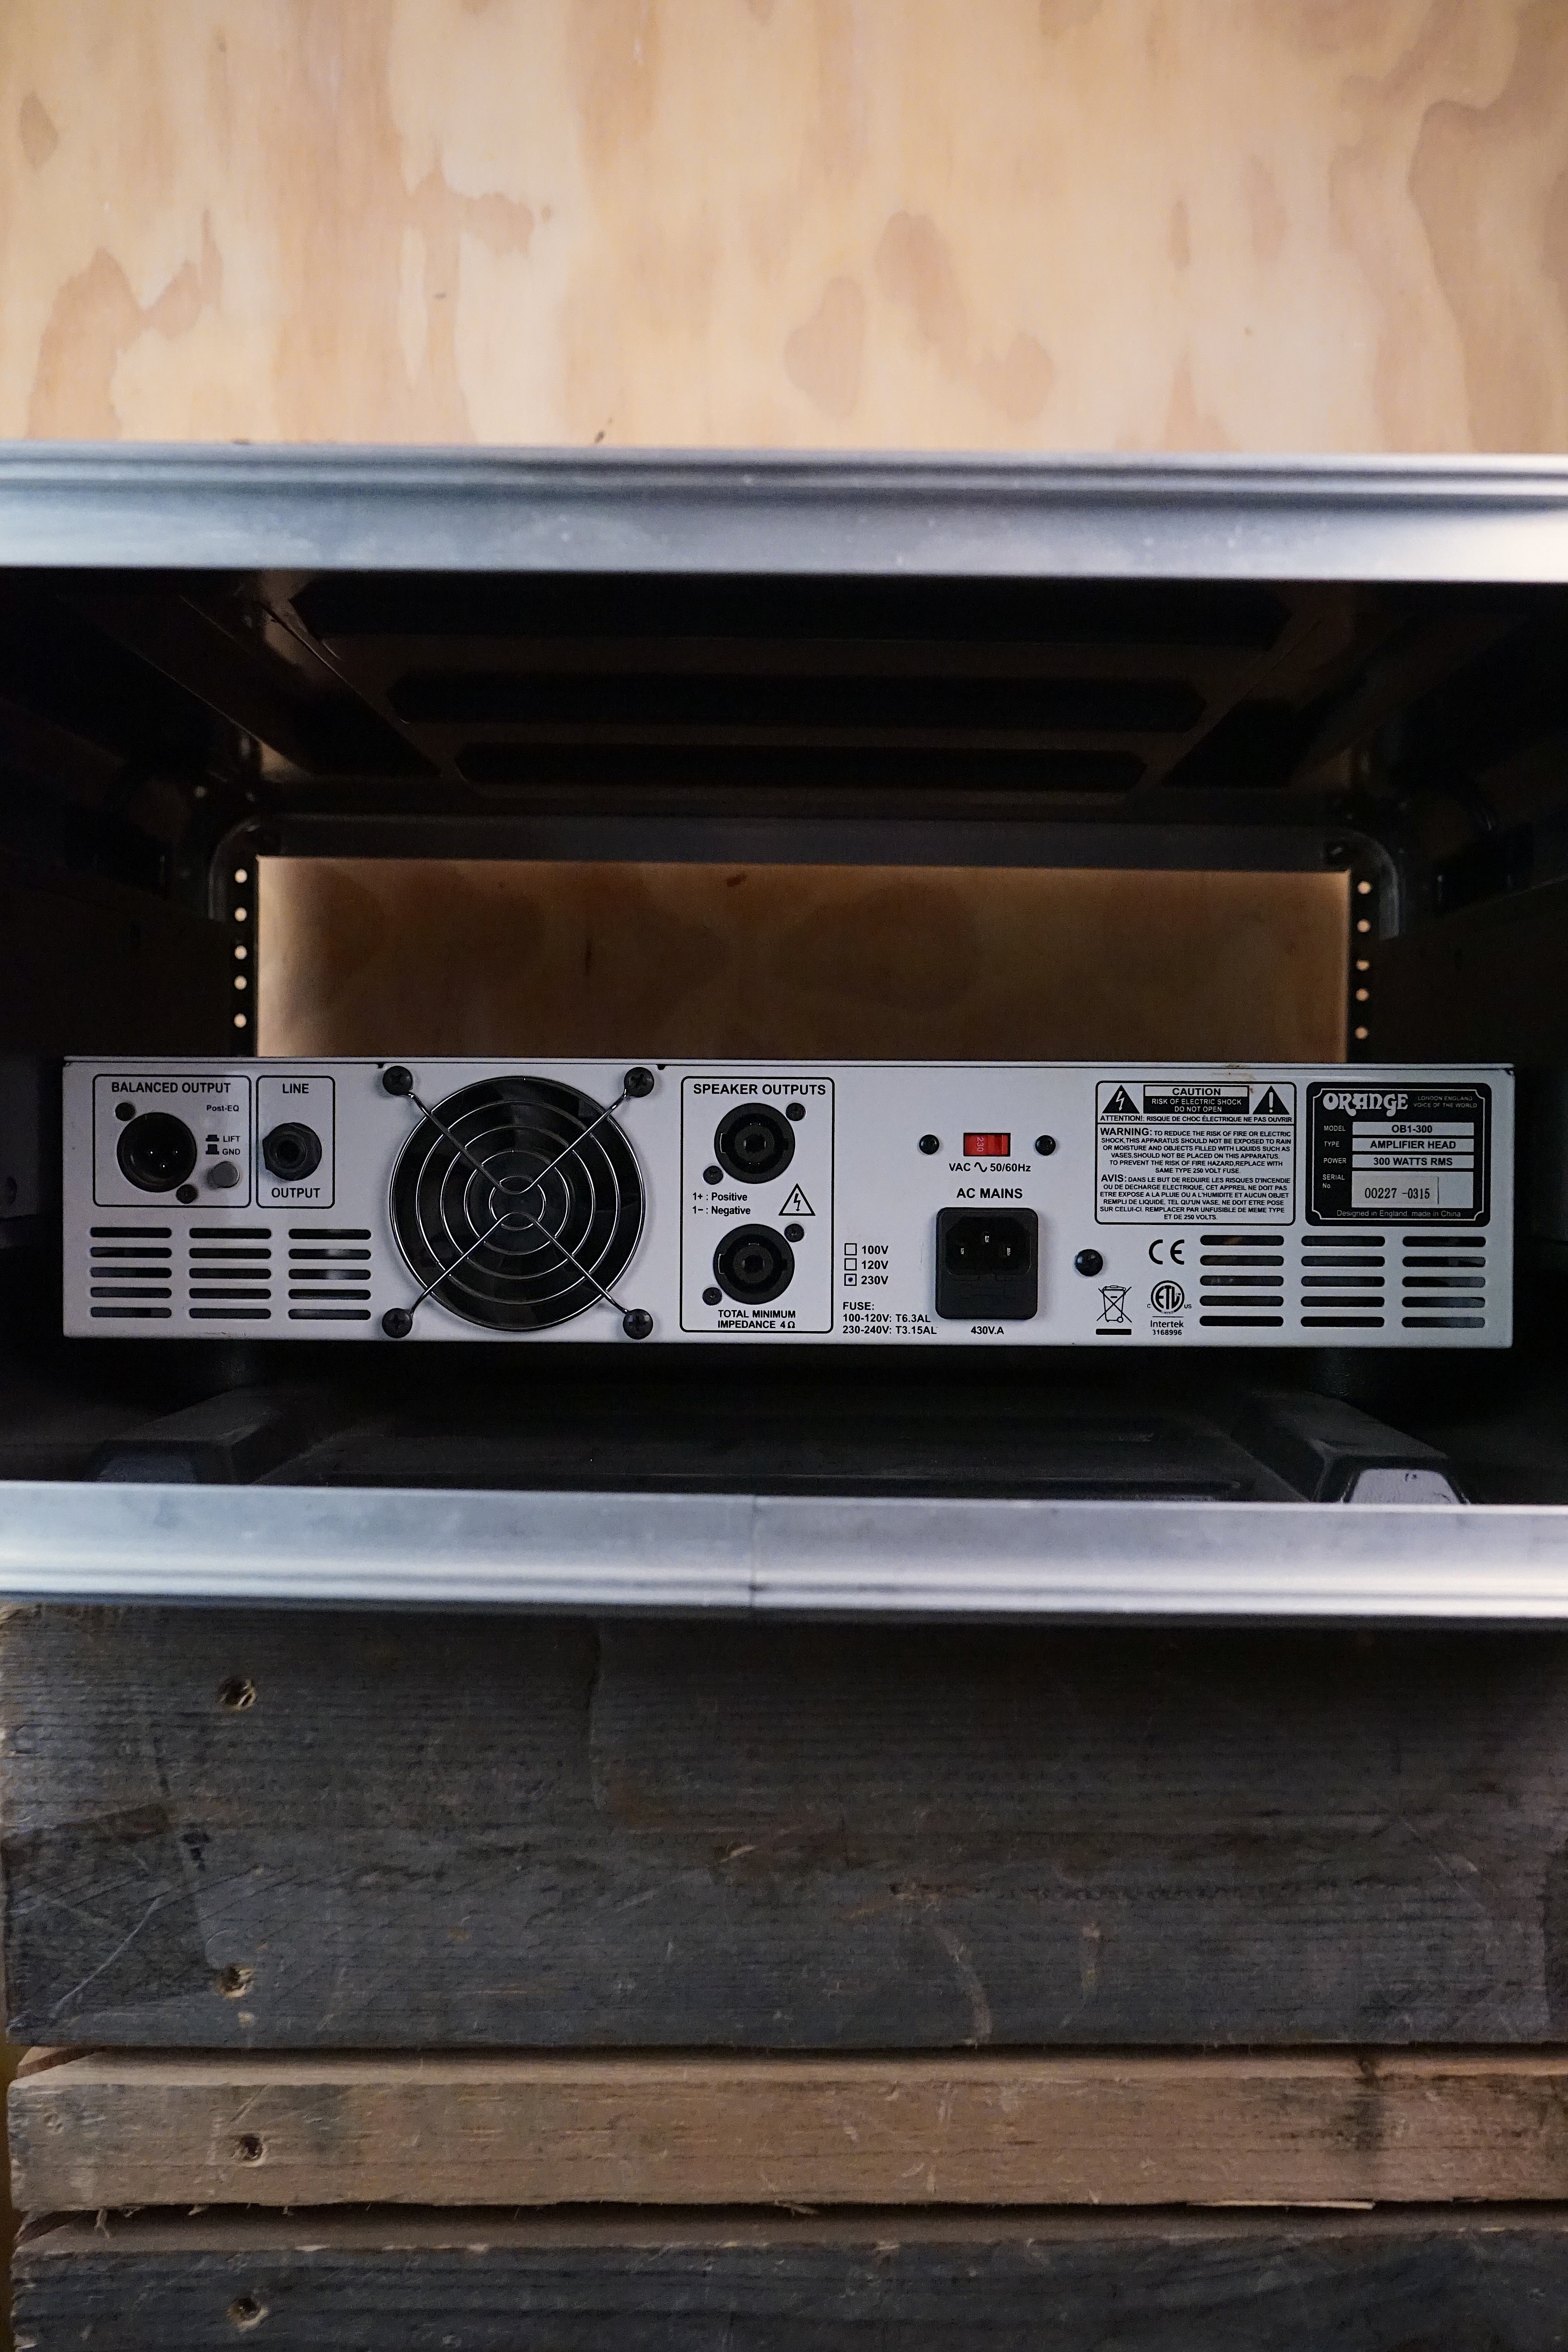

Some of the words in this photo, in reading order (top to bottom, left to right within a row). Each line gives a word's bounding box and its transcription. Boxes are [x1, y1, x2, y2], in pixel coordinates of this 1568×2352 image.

[112, 1082, 178, 1093] BALANCED
[182, 1082, 230, 1093] OUTPUT
[283, 1083, 309, 1093] LINE
[694, 1084, 758, 1094] SPEAKER
[762, 1084, 826, 1095] OUTPUTS
[1172, 1088, 1221, 1096] CAUTION
[1323, 1093, 1408, 1116] ORANGE
[1392, 1125, 1432, 1133] OB1-300
[1431, 1158, 1452, 1166] RMS
[949, 1163, 971, 1171] VAC
[990, 1163, 1031, 1172] 50/60Hz
[272, 1188, 320, 1198] OUTPUT
[712, 1192, 747, 1201] Positive
[956, 1188, 975, 1198] AC
[980, 1188, 1022, 1198] MAINS
[1365, 1188, 1397, 1198] 00227
[711, 1206, 750, 1216] Negative
[862, 1245, 888, 1254] 100V
[1149, 1240, 1184, 1265] CE
[862, 1260, 888, 1269] 120V
[861, 1276, 888, 1285] 230V
[843, 1302, 874, 1310] FUSE:
[843, 1314, 891, 1322] 100-120V:
[895, 1314, 931, 1322] T6.3AL
[843, 1325, 891, 1334] 230-240V:
[895, 1326, 937, 1334] T3.15AL
